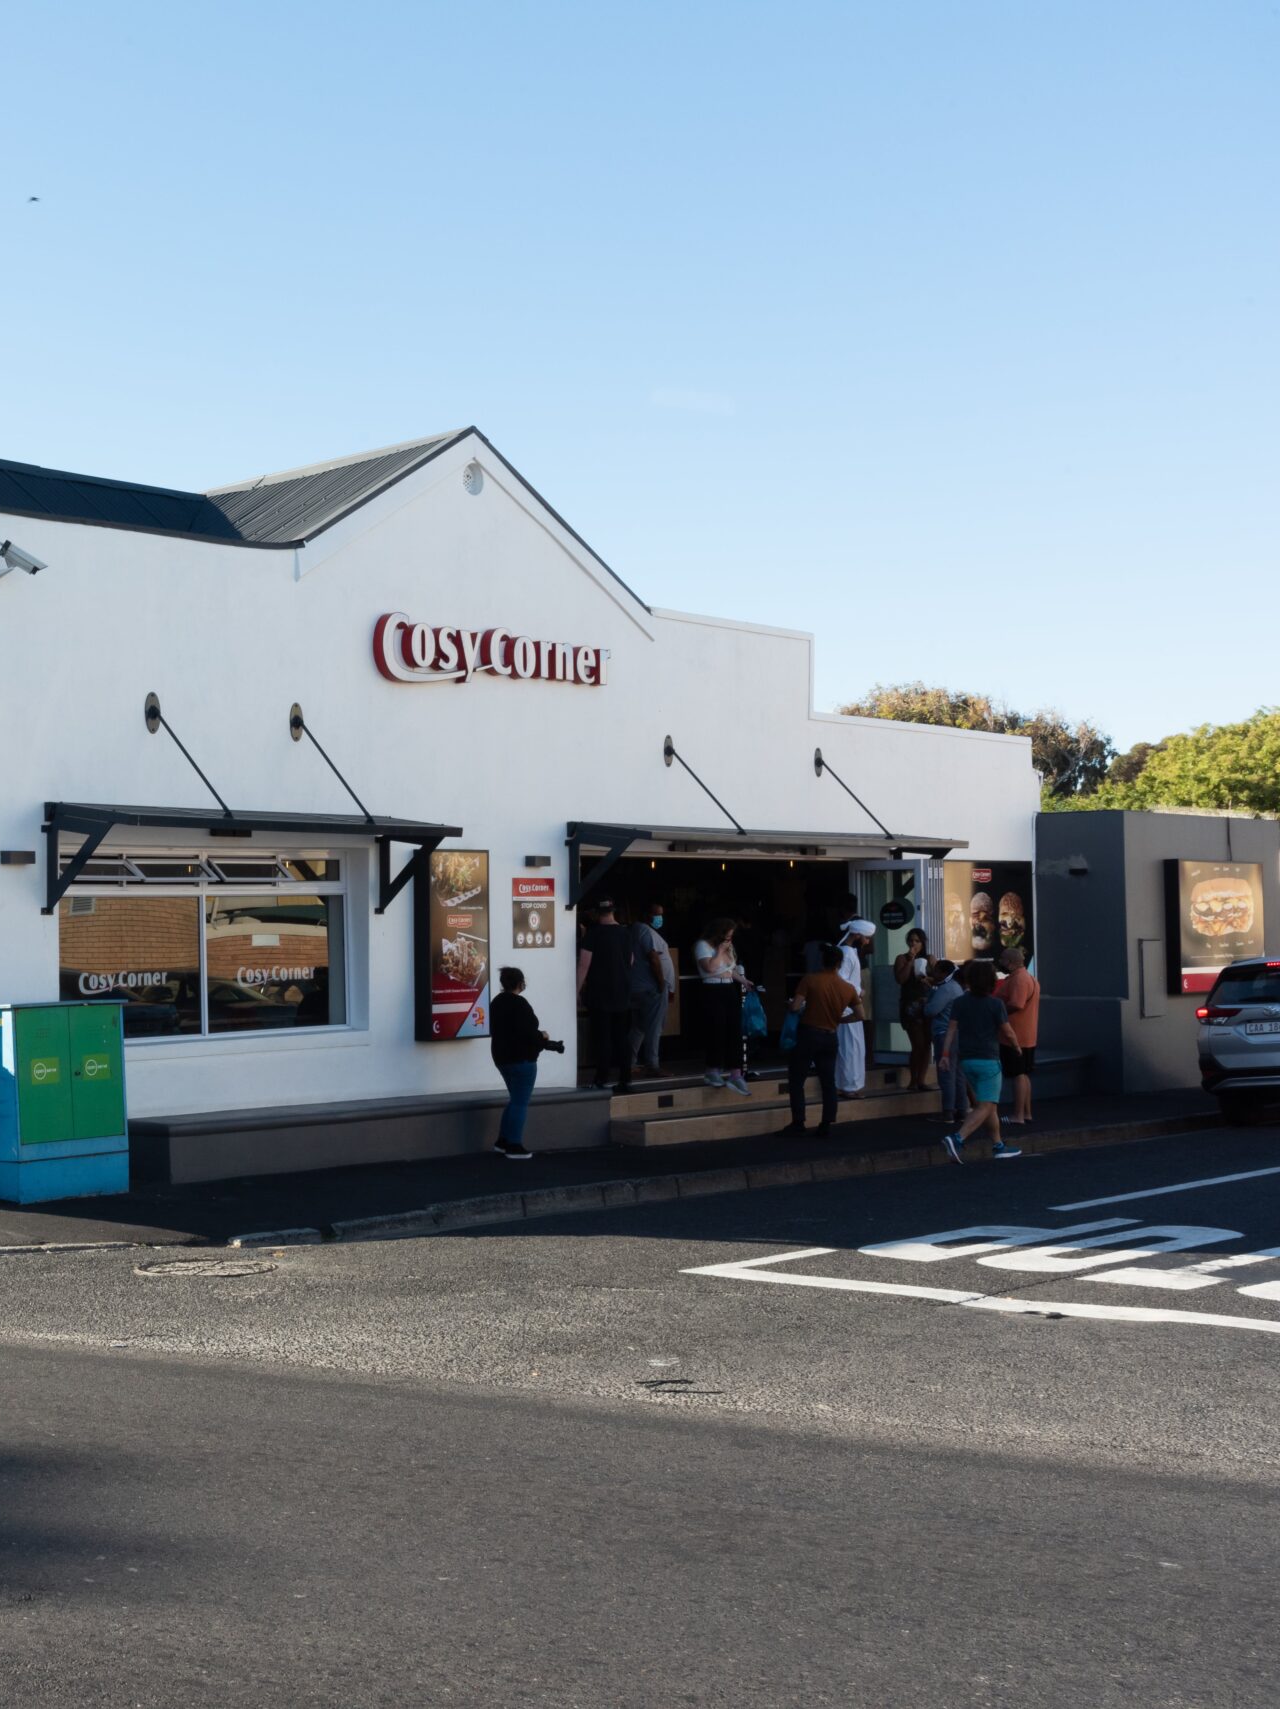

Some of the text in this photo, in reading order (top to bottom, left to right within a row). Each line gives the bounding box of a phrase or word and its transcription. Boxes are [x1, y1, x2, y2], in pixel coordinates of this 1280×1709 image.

[373, 612, 611, 685] Cosy Corner
[78, 970, 168, 995] Cosy Corner
[236, 965, 316, 988] Cosy Corner
[1249, 1022, 1280, 1033] CAA 18
